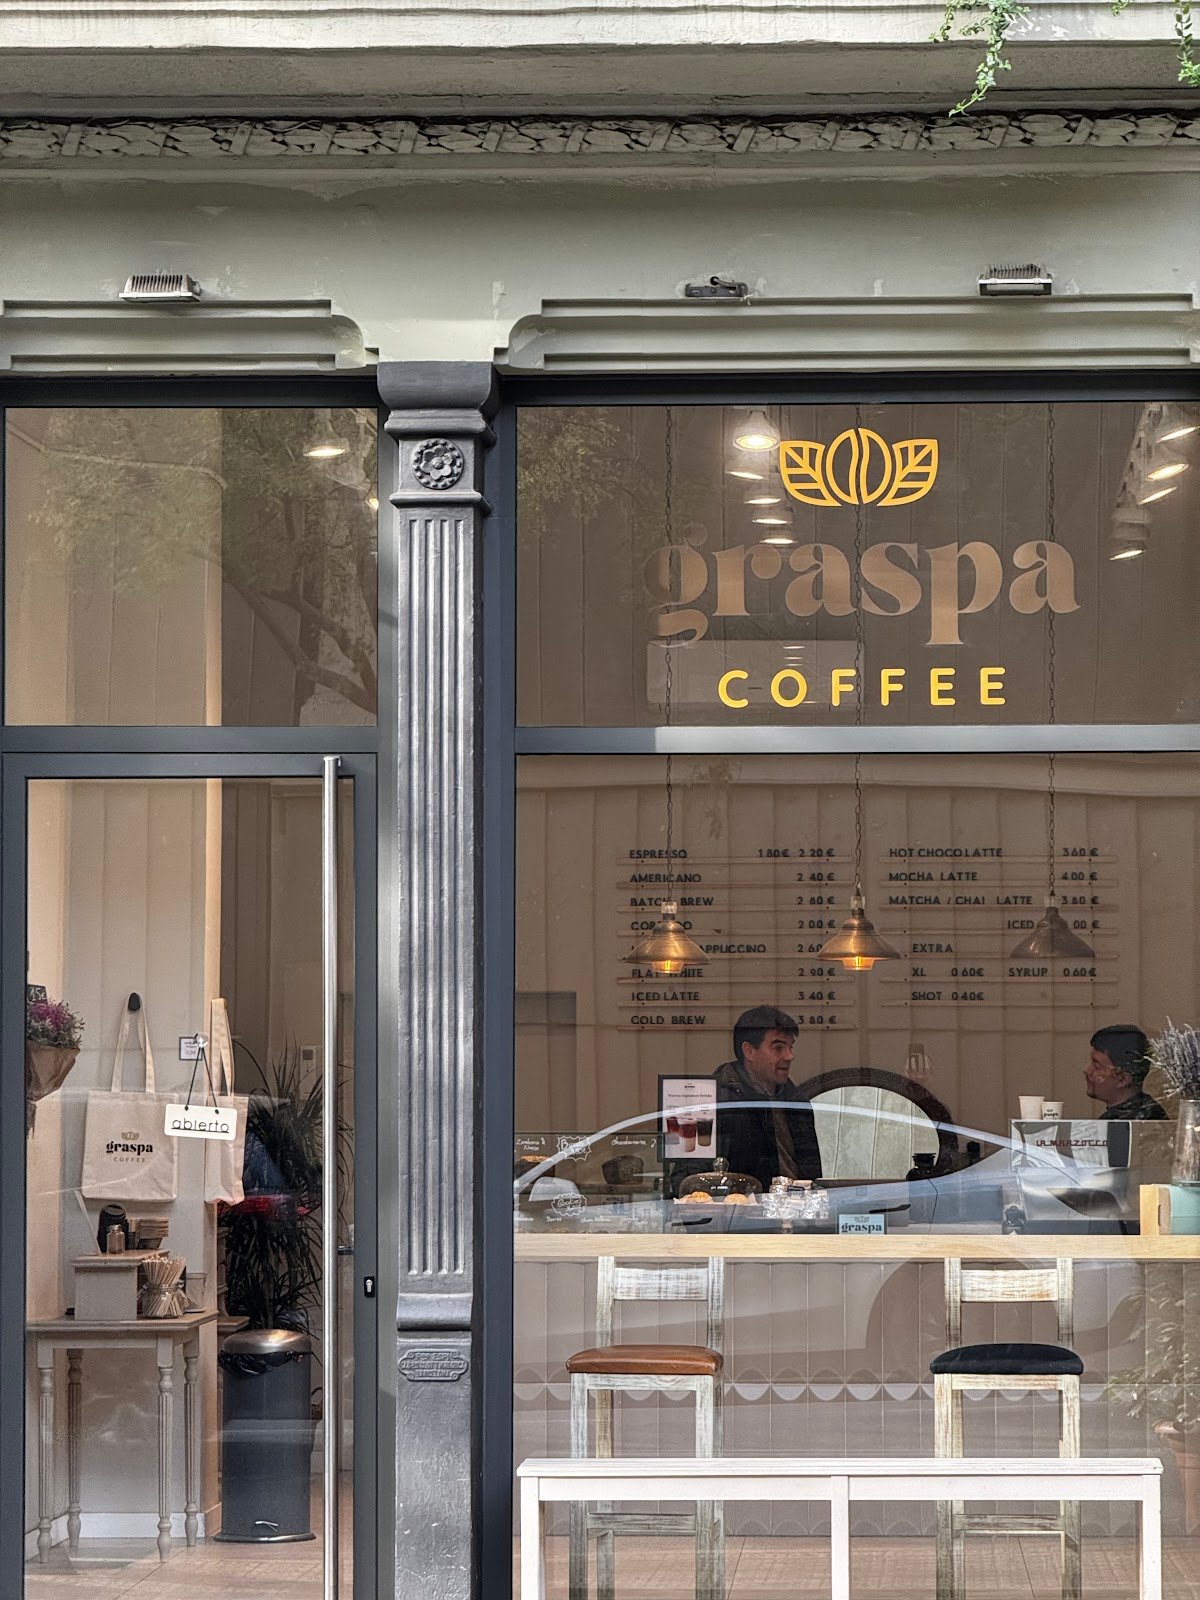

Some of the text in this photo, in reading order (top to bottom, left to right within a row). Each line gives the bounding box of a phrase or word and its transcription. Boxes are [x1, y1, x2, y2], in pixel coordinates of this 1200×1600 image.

[643, 522, 1081, 647] graspa
[718, 667, 1006, 708] COFFEE
[629, 849, 688, 859] ESPRESSO
[889, 848, 915, 858] HOT
[629, 873, 702, 883] AMERICANO
[888, 872, 934, 882] MOCHA
[940, 872, 978, 881] LATTE
[630, 898, 666, 907] BATC
[680, 897, 714, 906] BREW
[888, 896, 941, 905] MATCHA
[955, 896, 985, 905] CHAI
[996, 896, 1033, 905] LATTE
[1007, 920, 1035, 929] ICED
[912, 943, 953, 953] EXTRA
[912, 967, 927, 977] XL
[1008, 968, 1048, 977] SYRUP
[631, 992, 660, 1001] ICED
[663, 992, 700, 1001] LATTE
[911, 991, 942, 1001] SHOT
[631, 1016, 664, 1025] COLD
[671, 1015, 706, 1025] BREW
[171, 1117, 230, 1134] abierto
[106, 1140, 154, 1156] graspa
[841, 1222, 882, 1233] graspa
